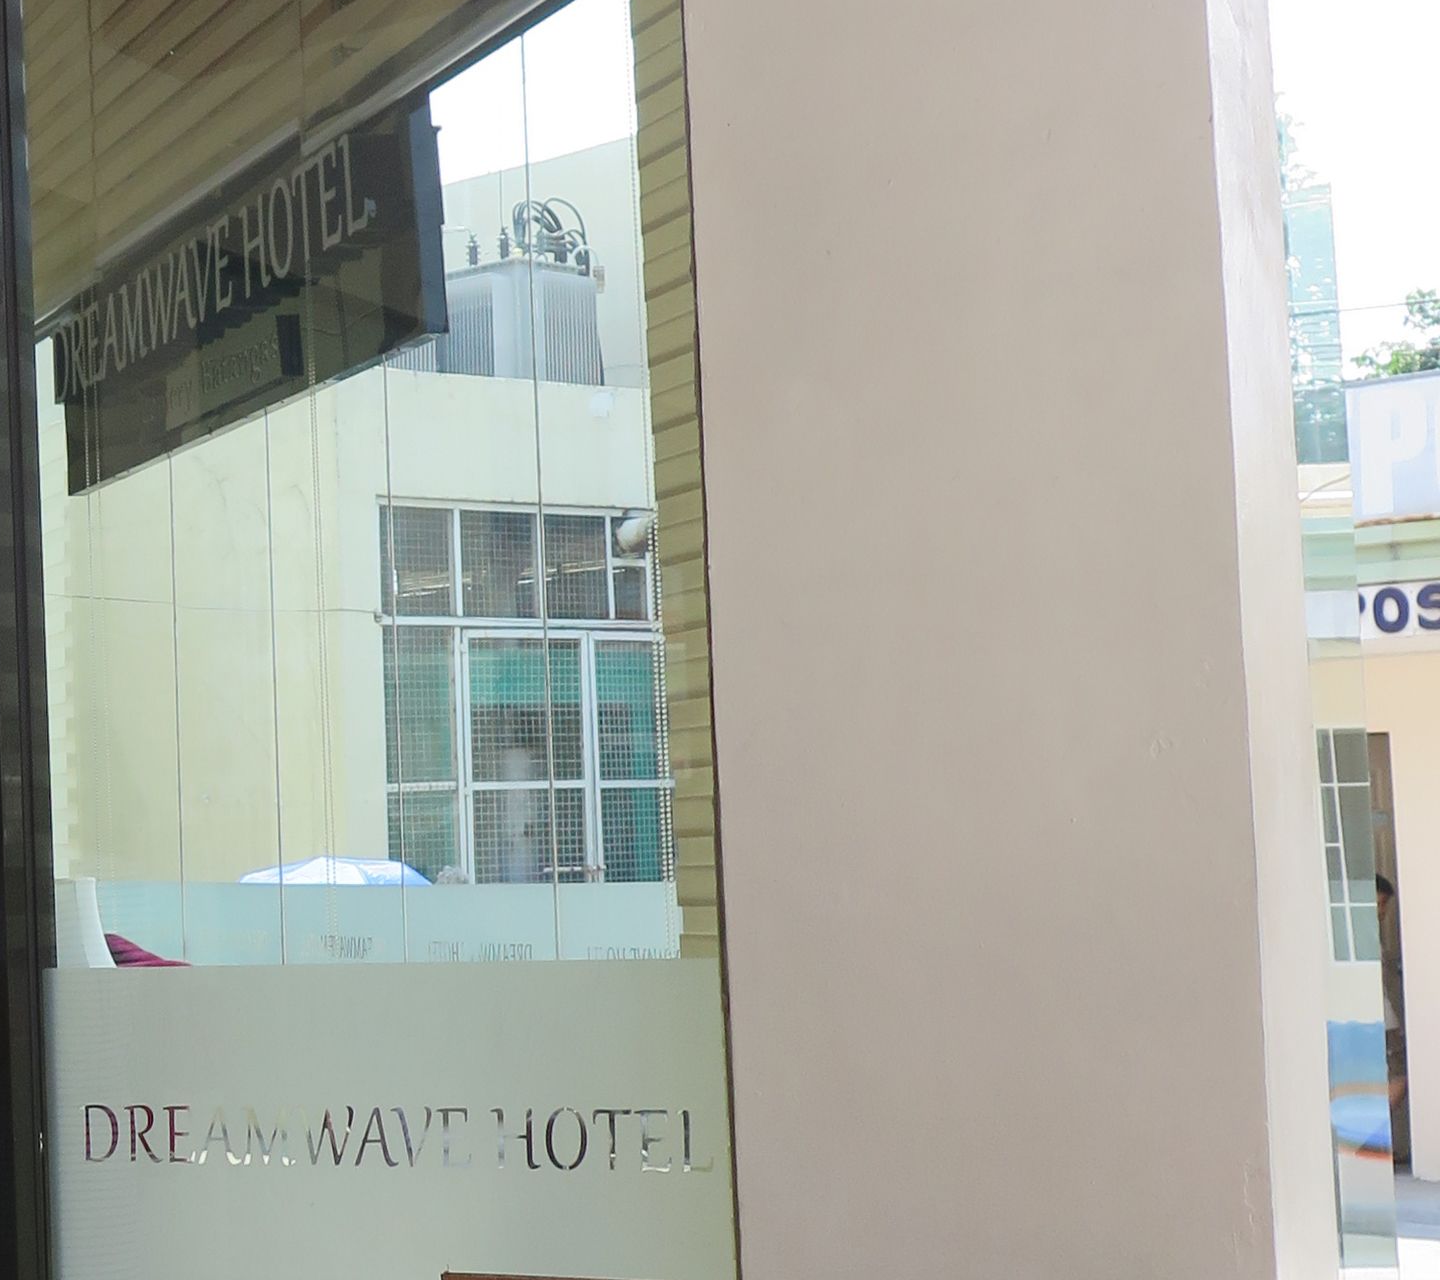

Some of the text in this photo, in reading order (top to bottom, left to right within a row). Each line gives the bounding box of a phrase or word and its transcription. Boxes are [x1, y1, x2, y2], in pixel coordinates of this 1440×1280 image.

[239, 133, 371, 299] HOTEL
[1359, 583, 1440, 634] OS
[82, 1103, 713, 1173] DREAMWAVE HOTEL
